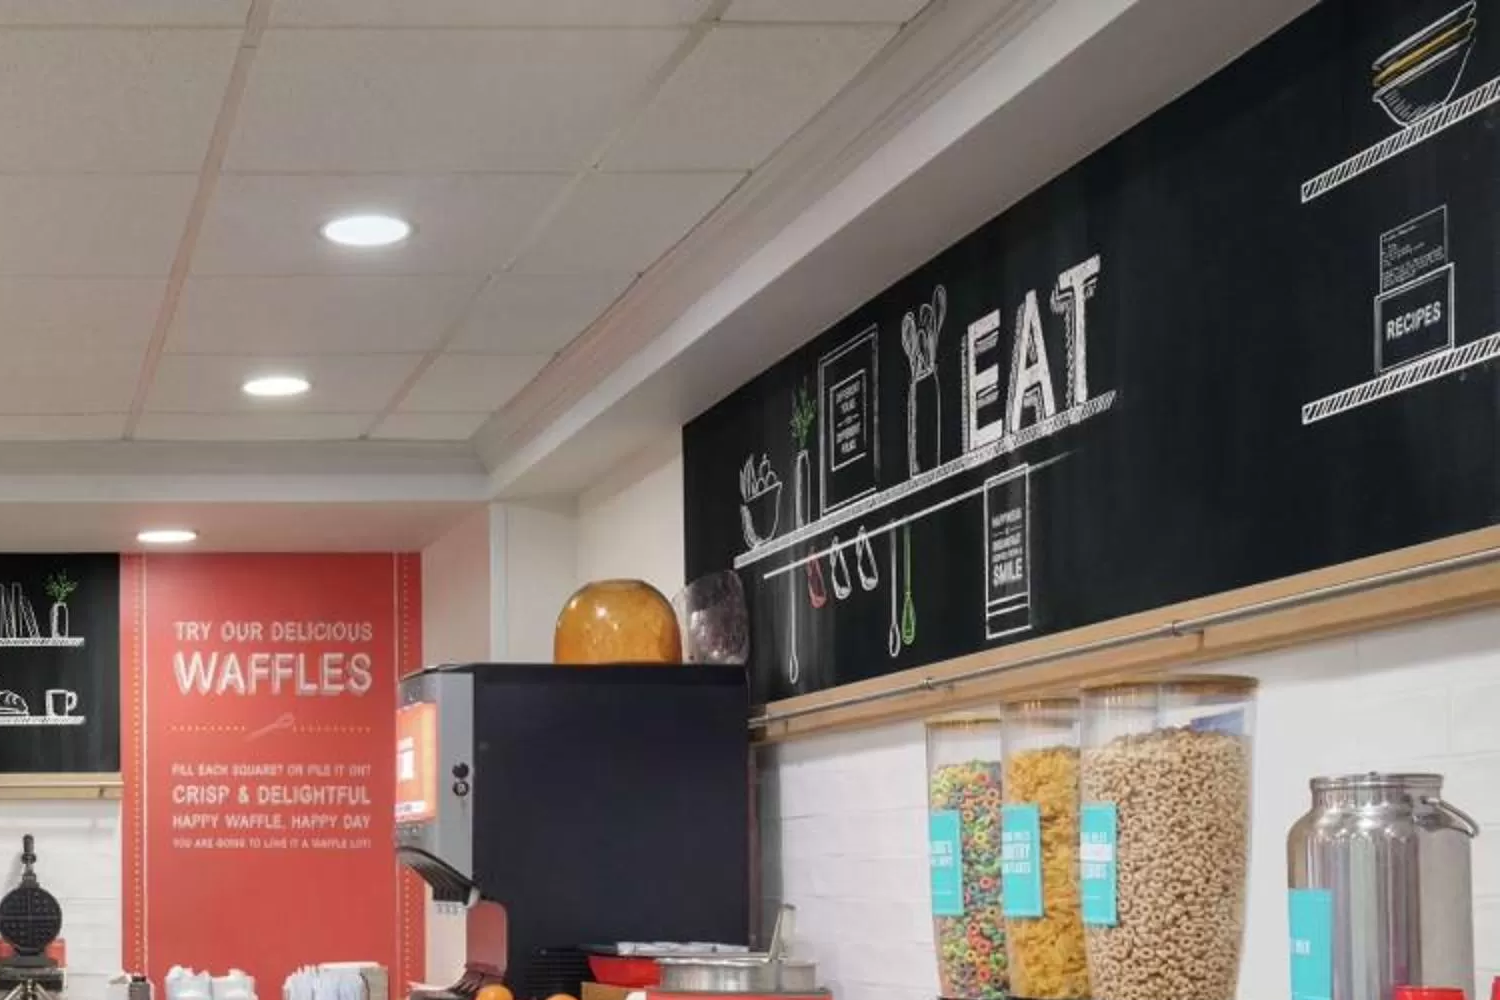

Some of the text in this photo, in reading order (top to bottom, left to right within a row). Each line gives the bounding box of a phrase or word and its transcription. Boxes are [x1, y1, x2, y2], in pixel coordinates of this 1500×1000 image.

[1386, 301, 1441, 341] RECIPES
[961, 253, 1101, 454] EAT
[174, 621, 372, 642] TRY OUR DELICIOUS
[173, 651, 372, 696] WAFFLES
[172, 784, 371, 806] CRISP & DELIGHTFUL
[173, 814, 219, 830] HAPPY
[291, 814, 337, 830] HAPPY
[343, 814, 371, 830] DAY
